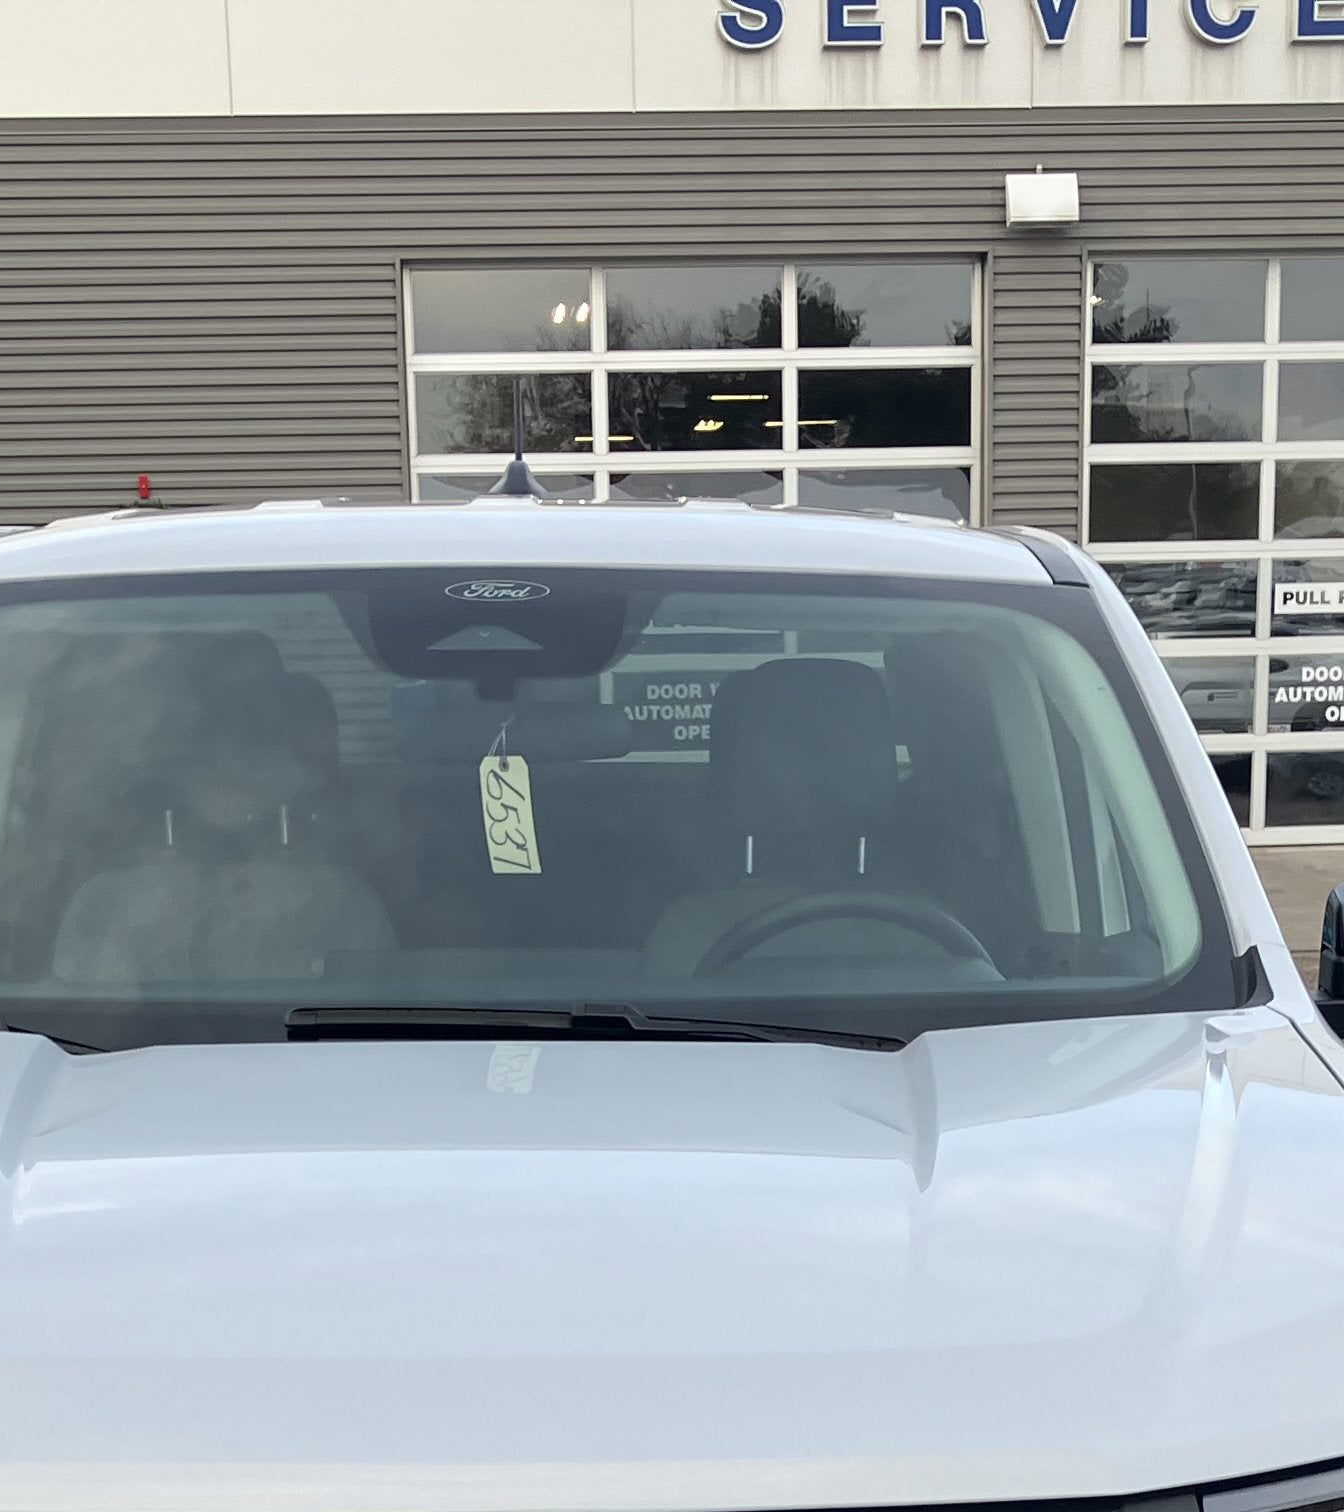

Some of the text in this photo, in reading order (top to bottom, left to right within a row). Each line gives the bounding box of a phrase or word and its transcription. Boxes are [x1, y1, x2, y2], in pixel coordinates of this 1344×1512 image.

[463, 582, 531, 599] Ford
[1282, 591, 1331, 606] PULL
[646, 684, 702, 700] DOOR
[485, 768, 533, 871] 6537
